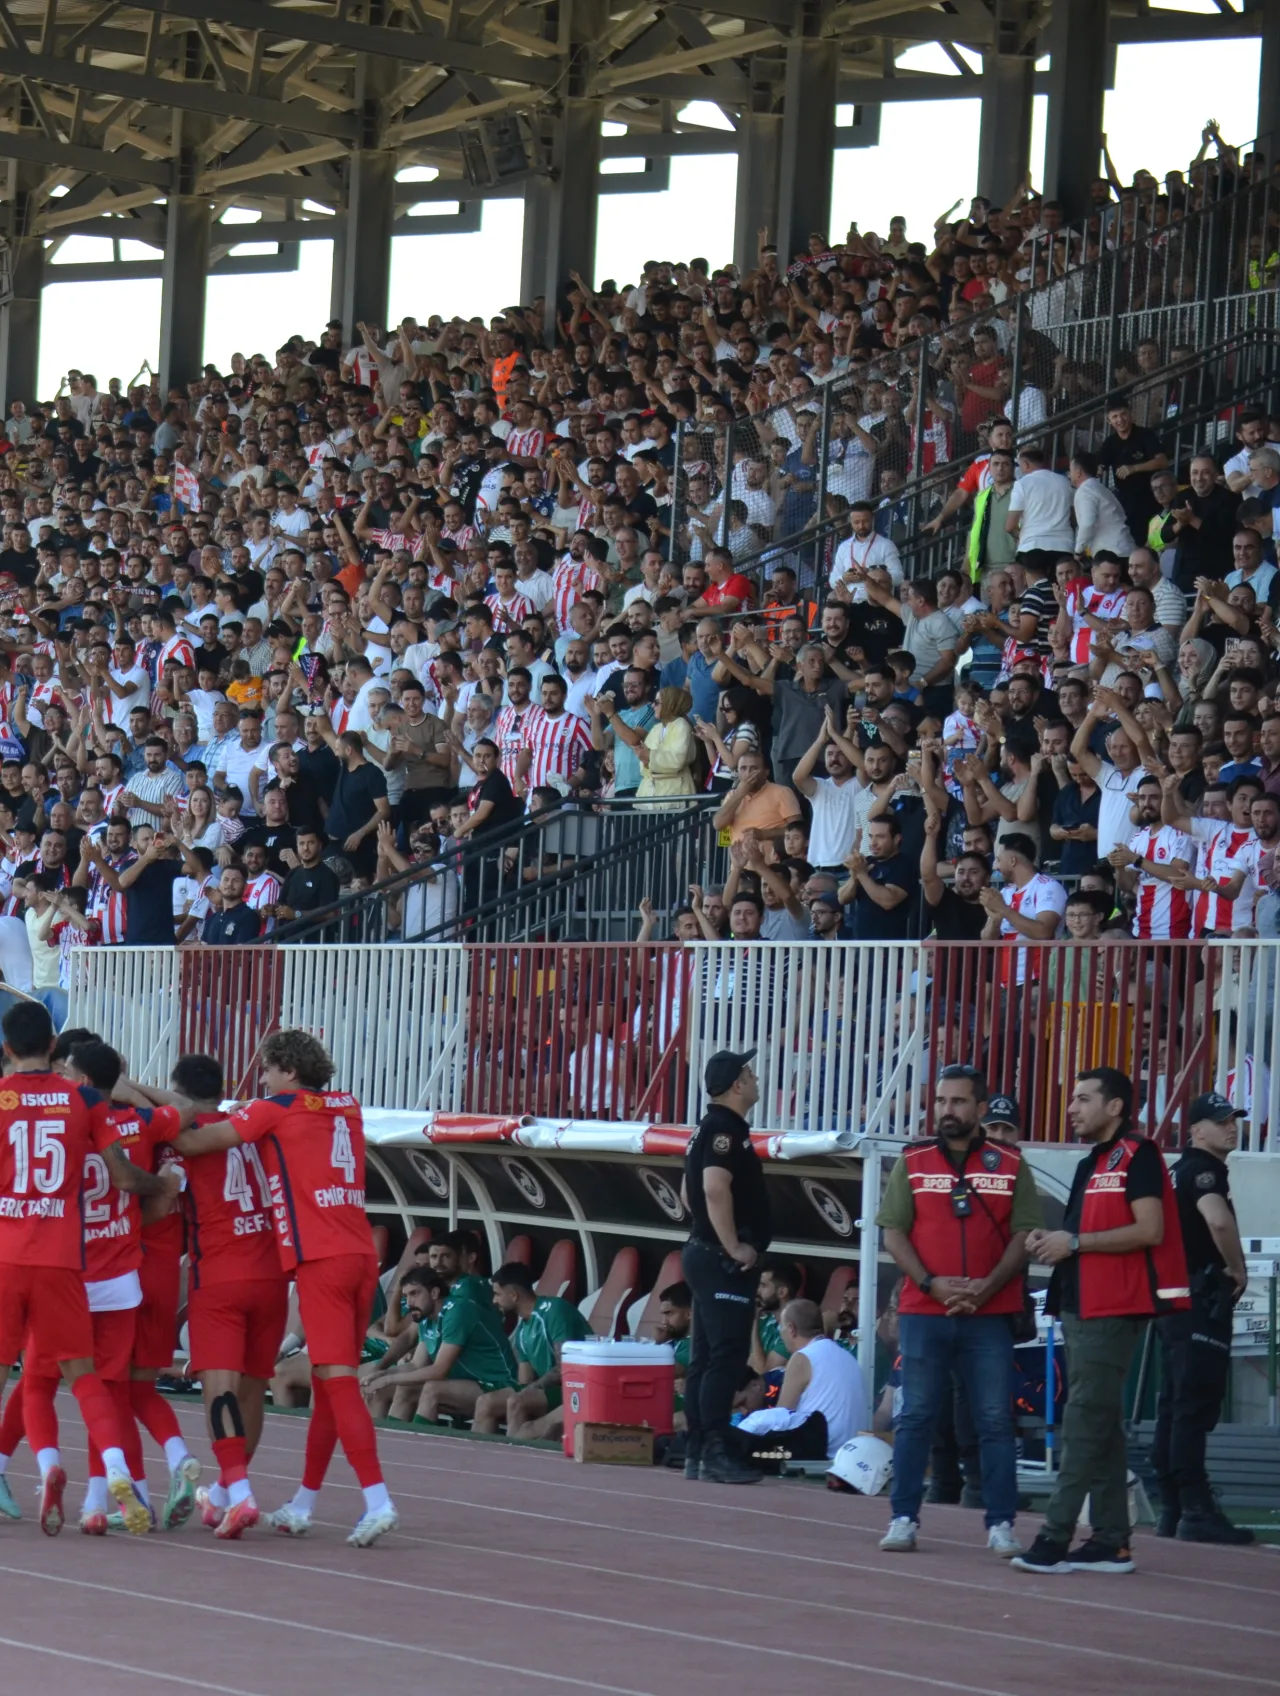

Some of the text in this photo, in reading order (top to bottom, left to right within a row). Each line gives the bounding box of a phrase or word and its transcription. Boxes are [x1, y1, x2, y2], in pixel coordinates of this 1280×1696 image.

[8, 1119, 65, 1194] 15
[223, 1141, 272, 1213] 41
[331, 1115, 356, 1184] 4
[922, 1177, 952, 1189] SPOR
[269, 1174, 293, 1247] ARSAN
